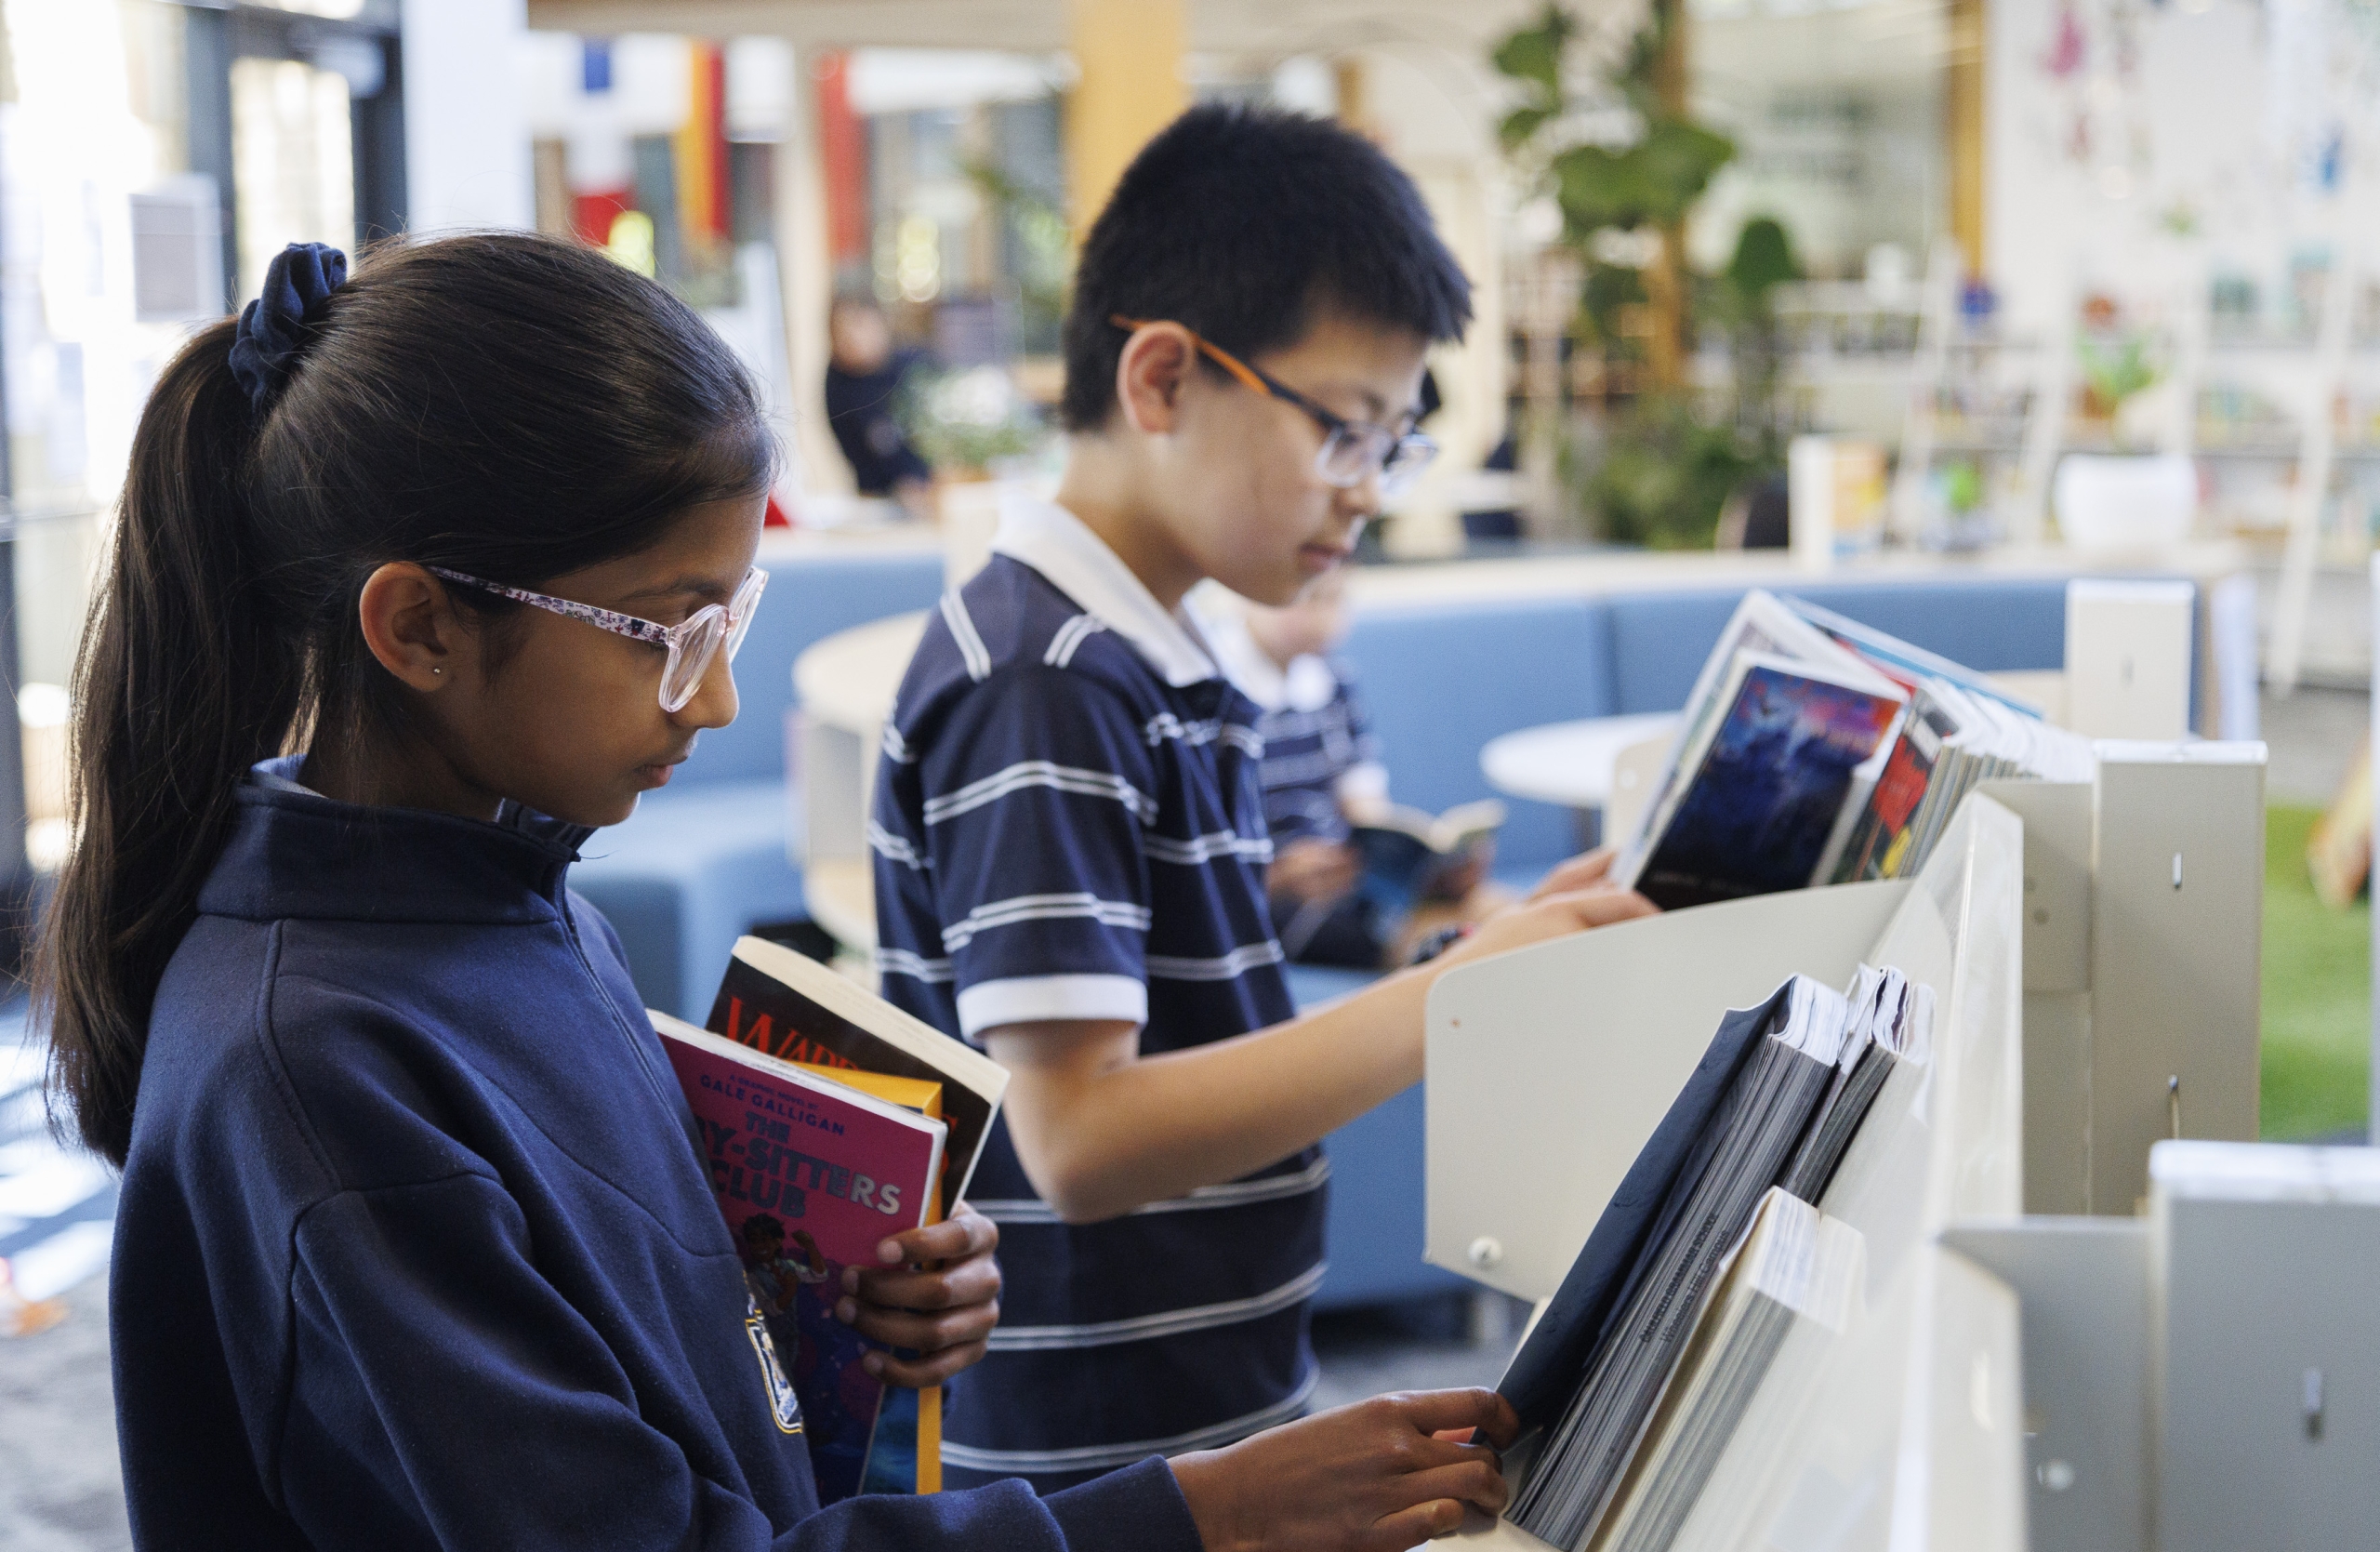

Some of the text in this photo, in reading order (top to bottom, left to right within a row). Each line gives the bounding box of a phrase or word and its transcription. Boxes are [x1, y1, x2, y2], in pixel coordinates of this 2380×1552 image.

[700, 1074, 845, 1136] GALE GALLIGAN
[746, 1110, 790, 1143] THE
[1686, 1272, 1705, 1293] Hill
[1697, 1227, 1731, 1275] Campus
